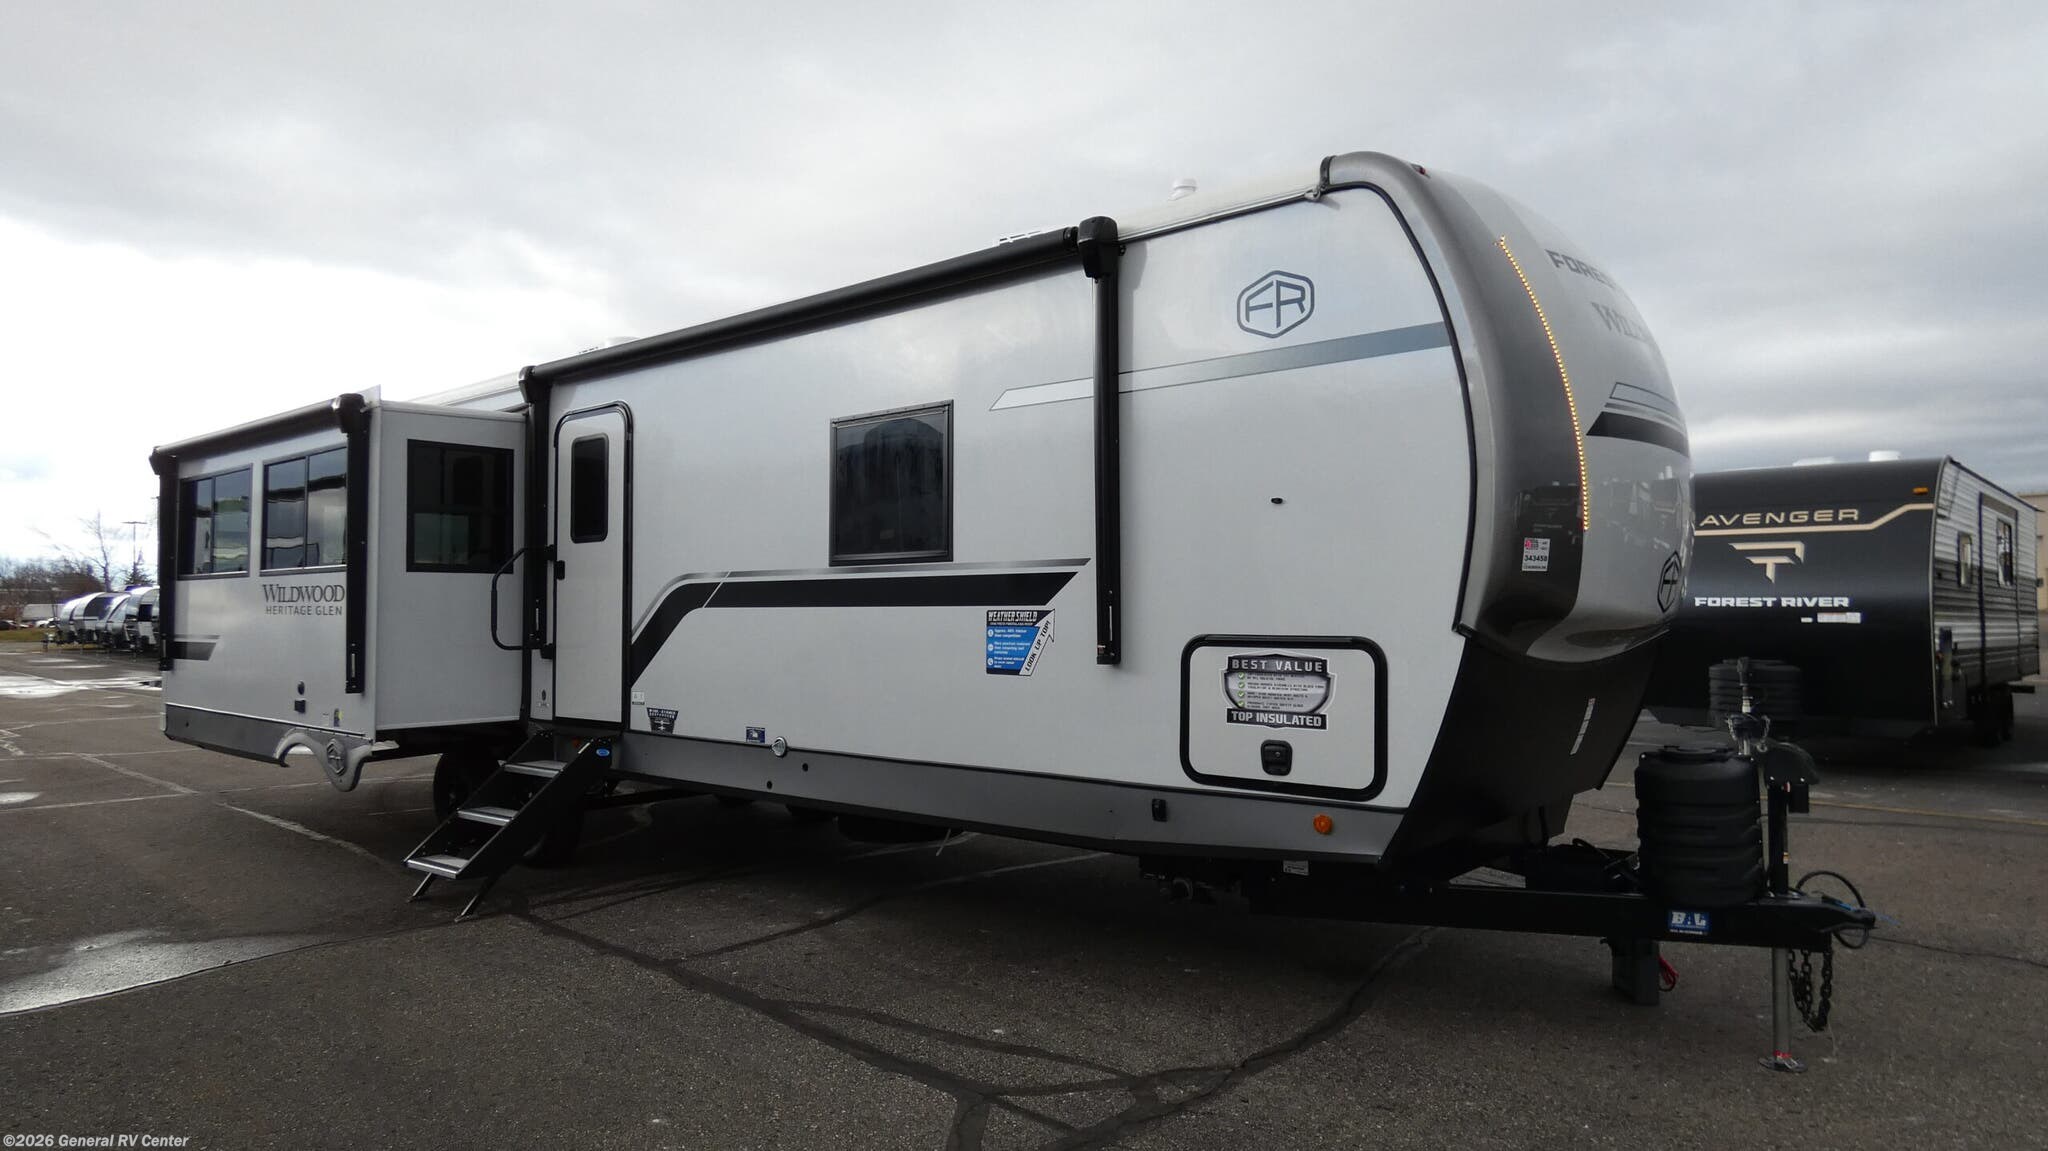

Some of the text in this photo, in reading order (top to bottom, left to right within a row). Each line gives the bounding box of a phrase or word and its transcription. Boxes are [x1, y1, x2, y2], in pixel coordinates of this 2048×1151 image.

[1699, 508, 1859, 527] AVENGER
[1694, 596, 1850, 608] FOREST RIVER
[265, 605, 343, 616] HERITAGE GLEN
[1231, 659, 1323, 673] BEST VALUE
[1231, 710, 1322, 727] TOP INSULATED
